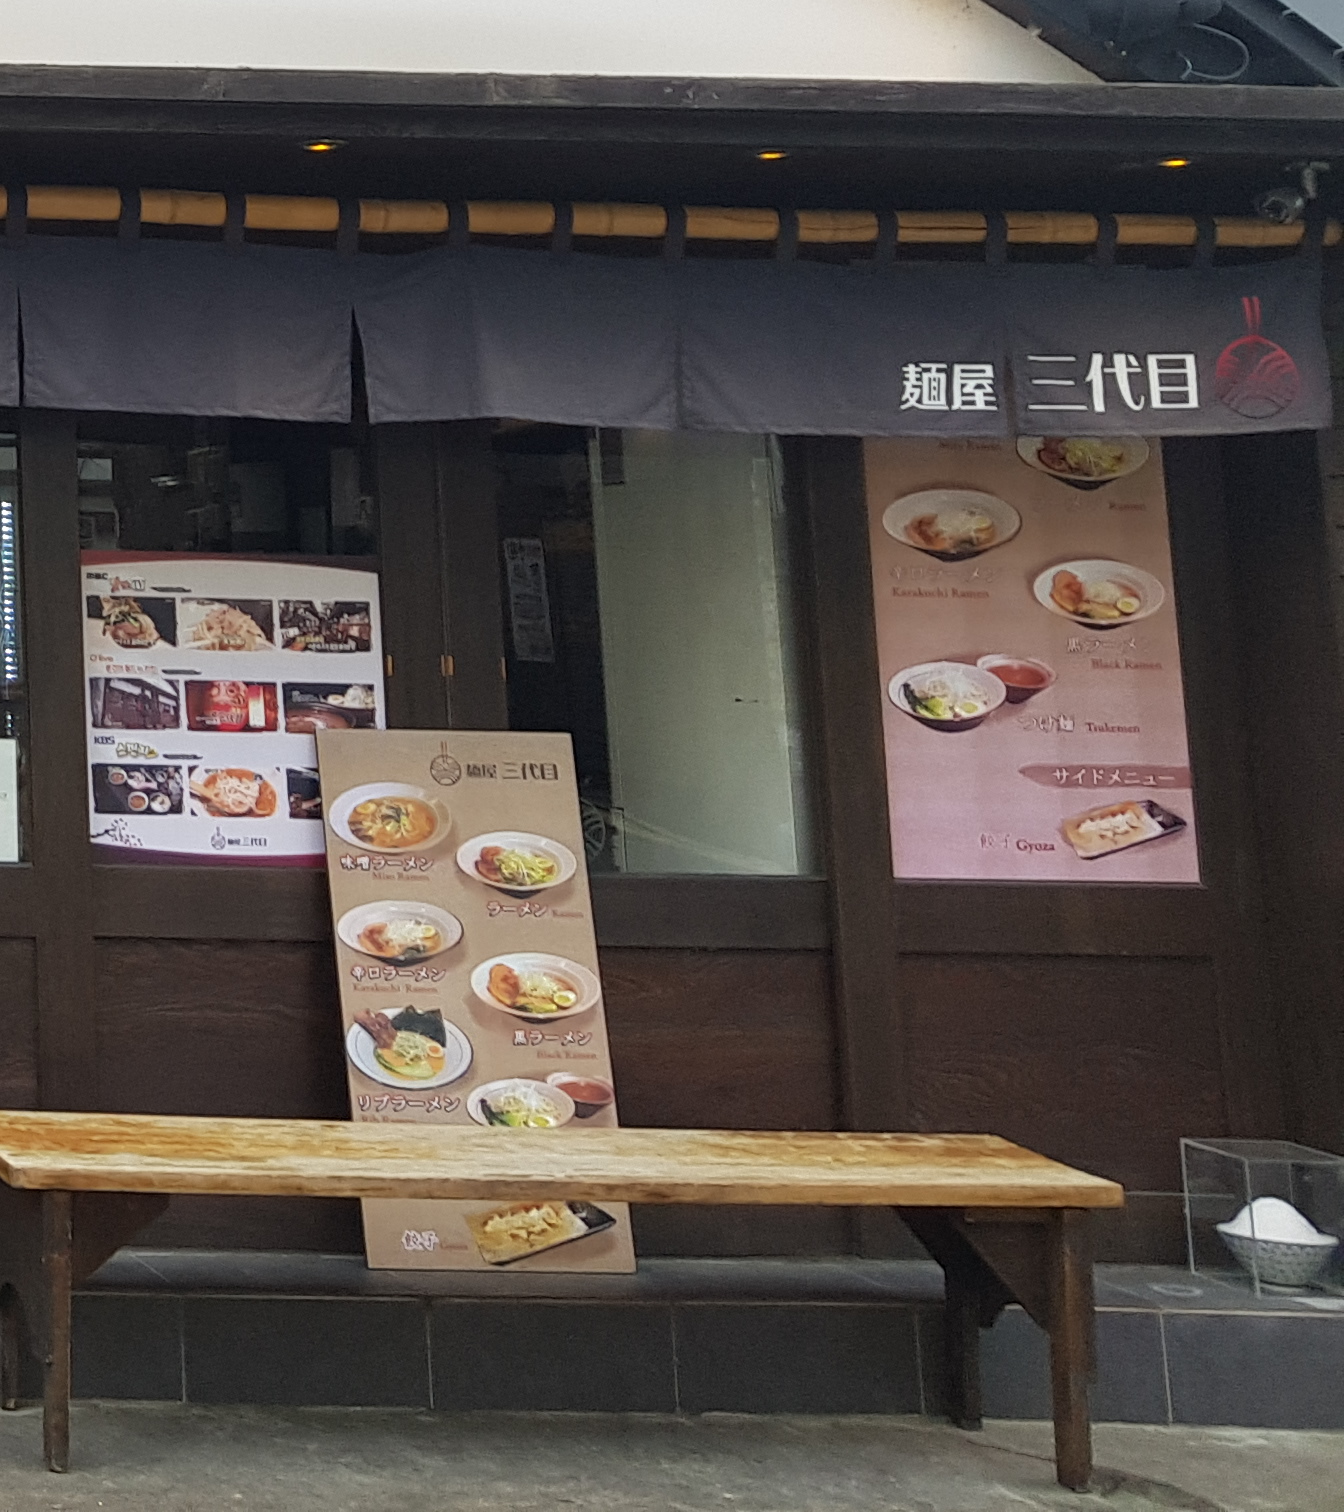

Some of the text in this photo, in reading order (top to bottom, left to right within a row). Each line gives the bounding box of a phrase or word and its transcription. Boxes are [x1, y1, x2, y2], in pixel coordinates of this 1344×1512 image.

[900, 352, 1199, 413] 麺屋 三代目
[1053, 768, 1175, 786] サイドメニュー
[1016, 839, 1056, 855] Gyoza
[487, 901, 549, 918] ラーメン
[513, 1029, 593, 1046] 黒ラーメン
[357, 1094, 461, 1113] リブラーメン
